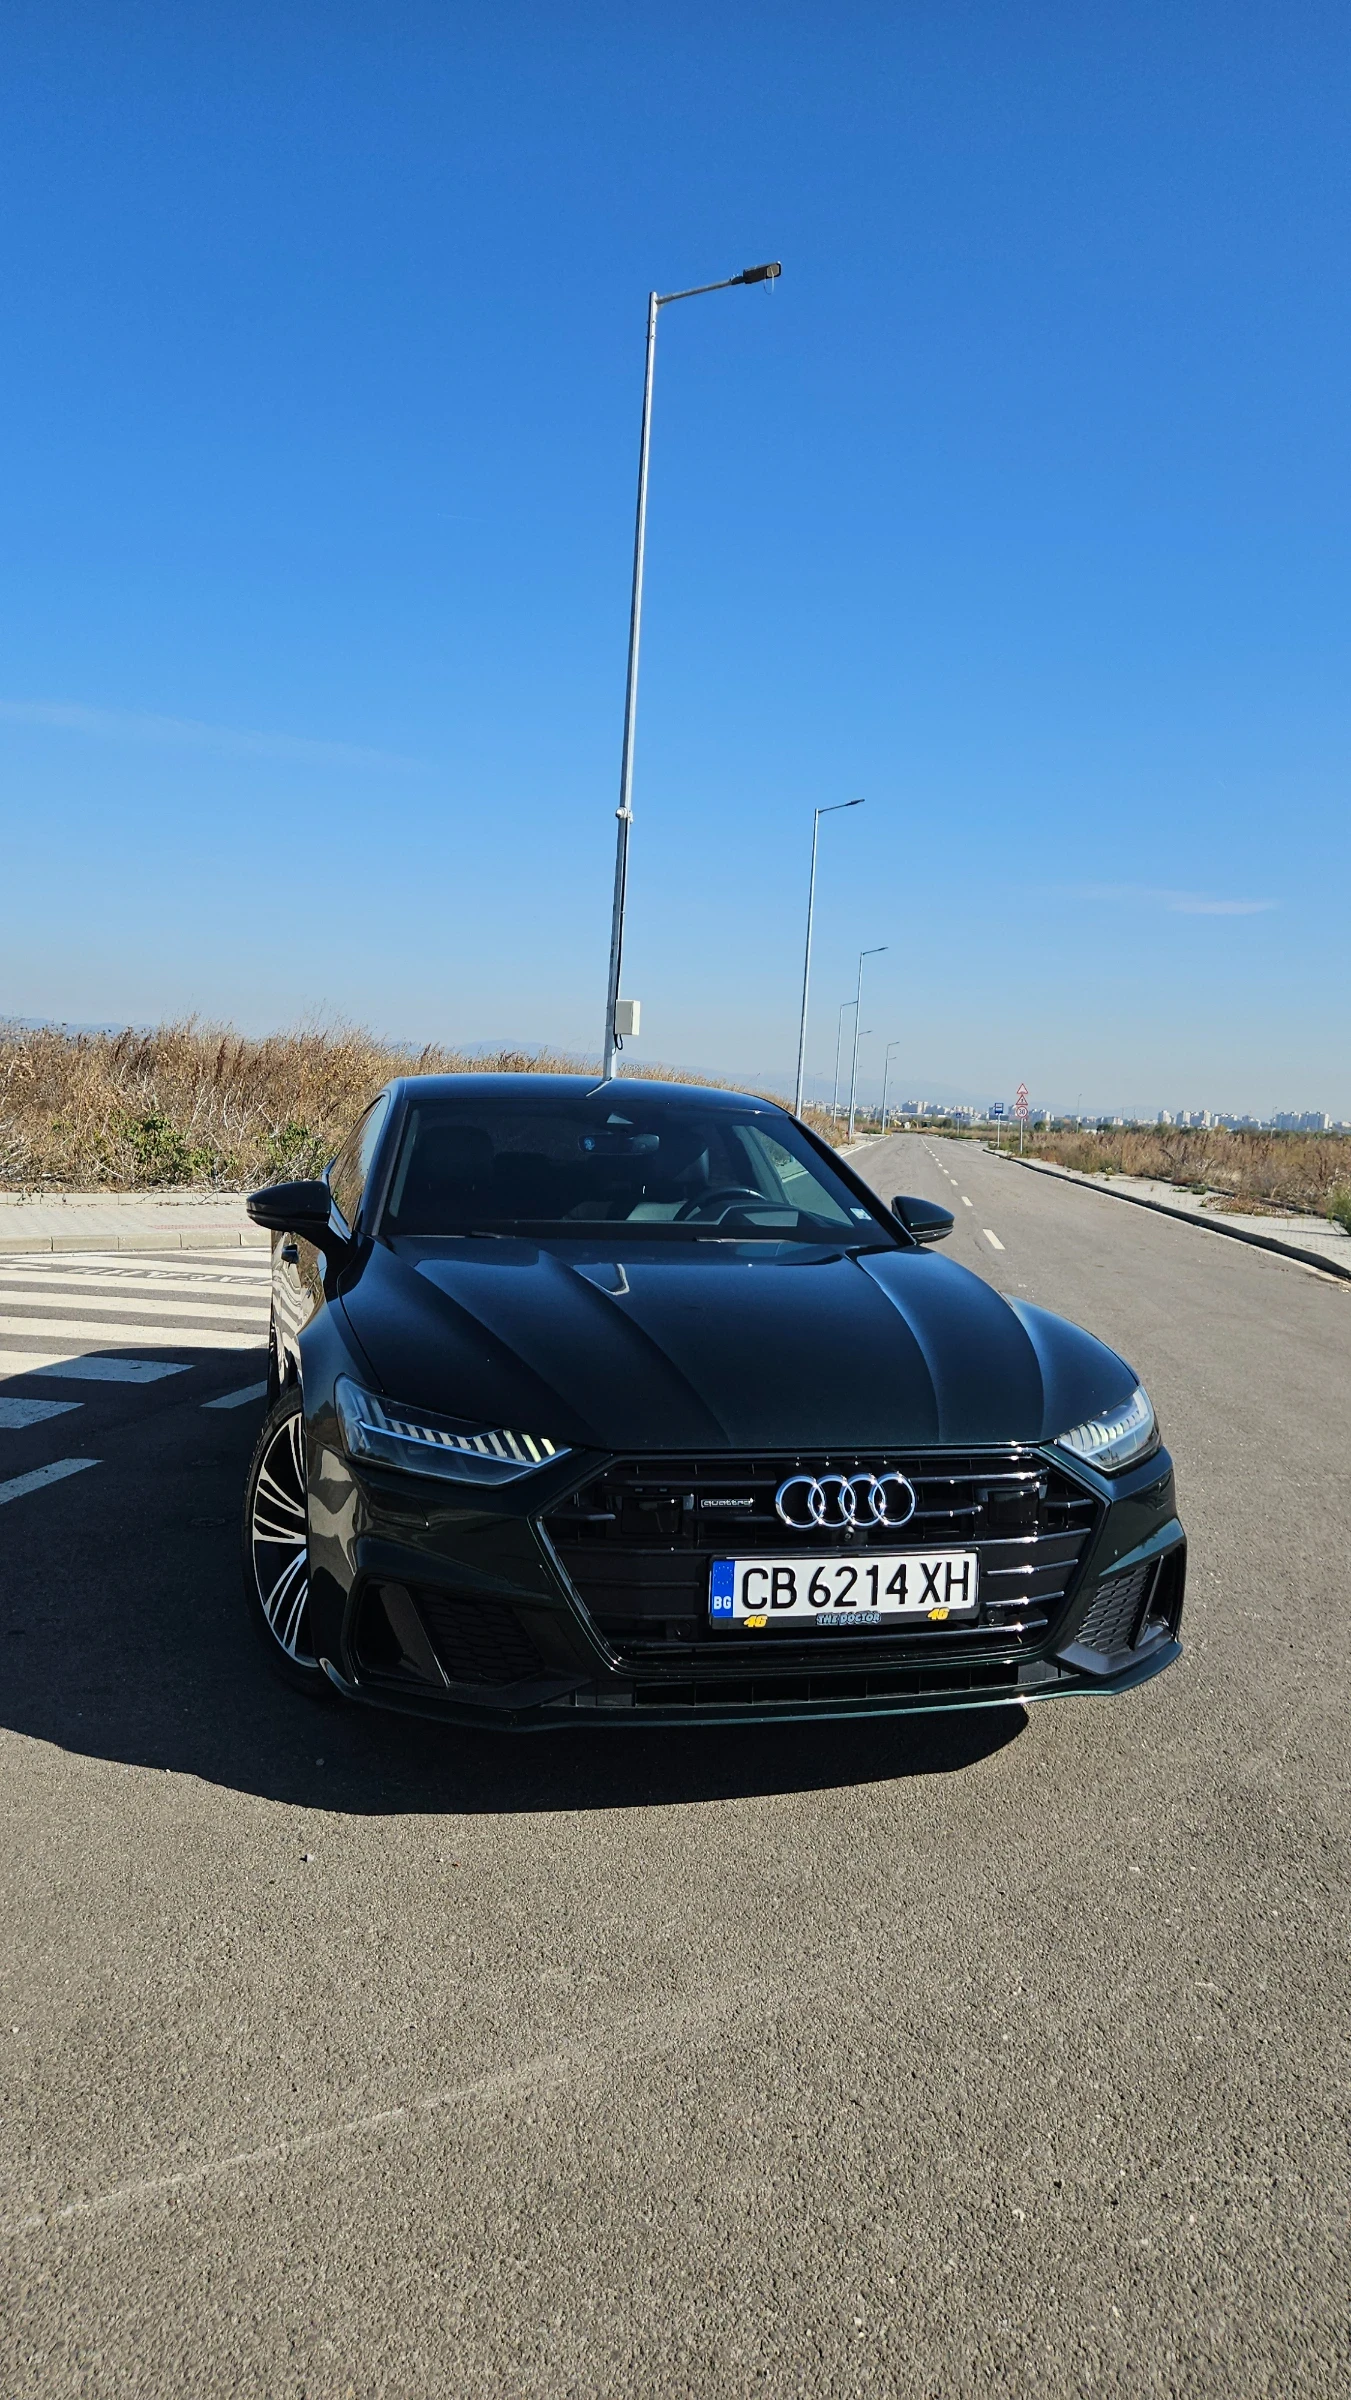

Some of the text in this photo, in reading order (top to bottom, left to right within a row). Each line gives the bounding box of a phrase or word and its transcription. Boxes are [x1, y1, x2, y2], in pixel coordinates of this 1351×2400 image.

[64, 1266, 272, 1286] ГЛЕДНИ
[741, 1560, 970, 1610] CB 6214 XH
[713, 1595, 732, 1610] BG
[743, 1614, 768, 1628] 46
[817, 1611, 881, 1625] THE DOCTOR
[927, 1607, 950, 1621] 46
